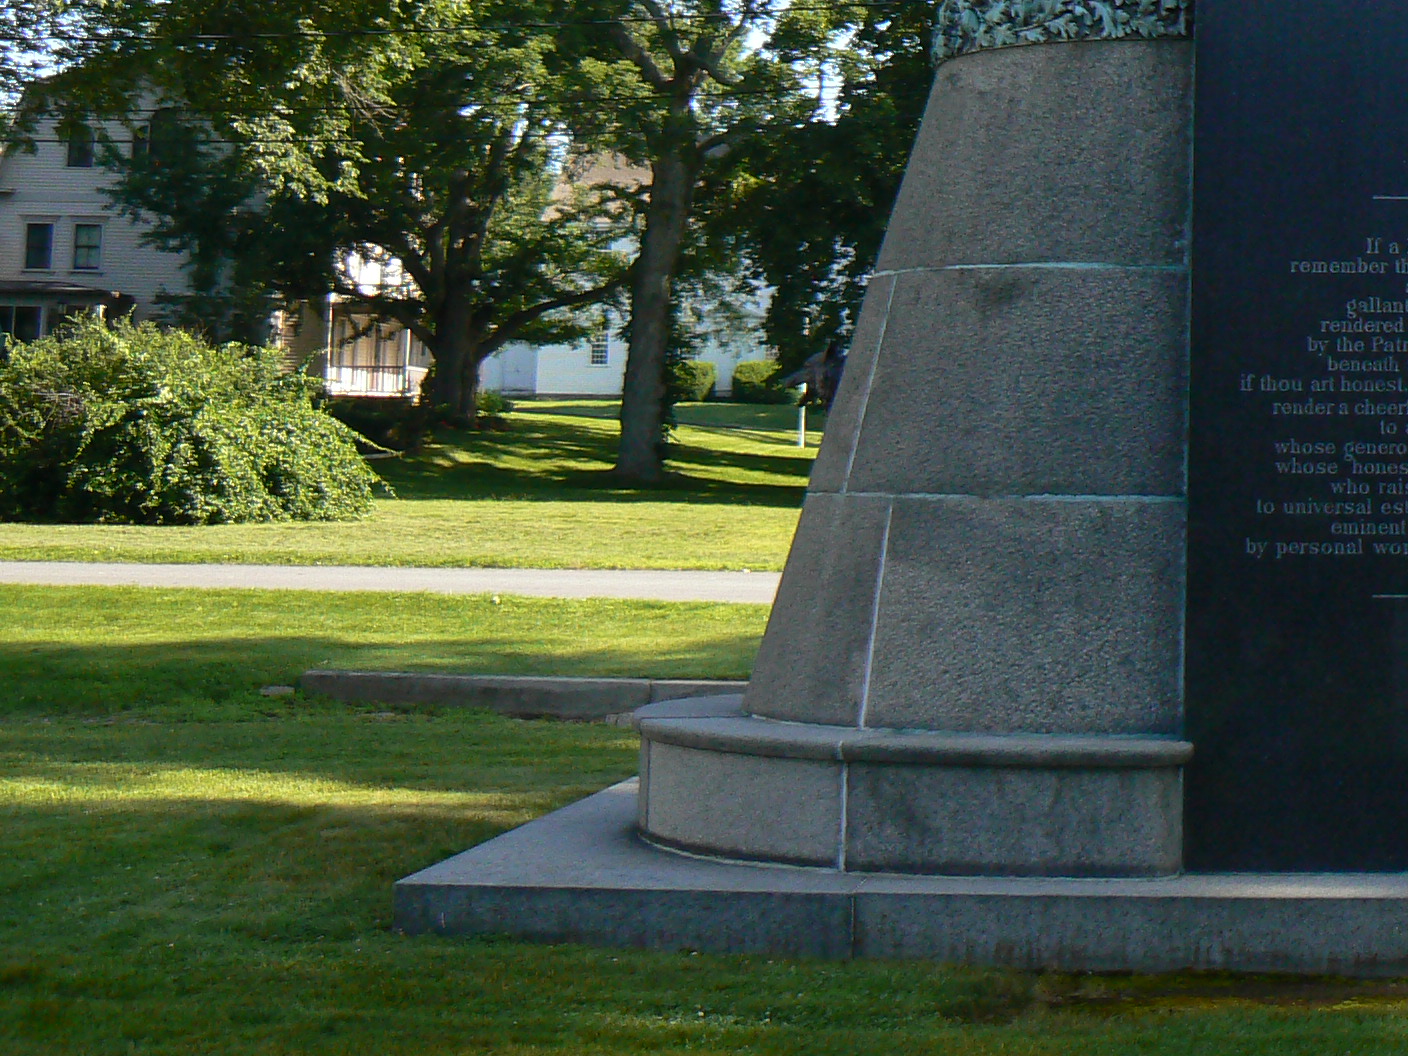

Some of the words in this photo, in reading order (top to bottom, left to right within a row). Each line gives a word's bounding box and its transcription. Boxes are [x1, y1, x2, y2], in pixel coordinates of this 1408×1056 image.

[1365, 237, 1383, 254] If
[1388, 241, 1400, 254] a
[1289, 256, 1389, 274] remember
[1319, 315, 1405, 333] rendered
[1306, 335, 1330, 356] by
[1335, 335, 1365, 353] the
[1326, 354, 1400, 372] beneath
[1239, 374, 1256, 393] if
[1259, 374, 1304, 393] thou
[1310, 374, 1335, 393] art
[1272, 397, 1335, 416] render
[1338, 401, 1350, 416] a
[1379, 418, 1398, 435] to
[1274, 437, 1337, 455] whose
[1274, 457, 1339, 475] whose
[1330, 477, 1371, 495] who
[1256, 497, 1275, 516] to
[1283, 497, 1372, 516] universal
[1330, 517, 1407, 535] eminent
[1244, 537, 1268, 559] by
[1275, 537, 1363, 559] personal
